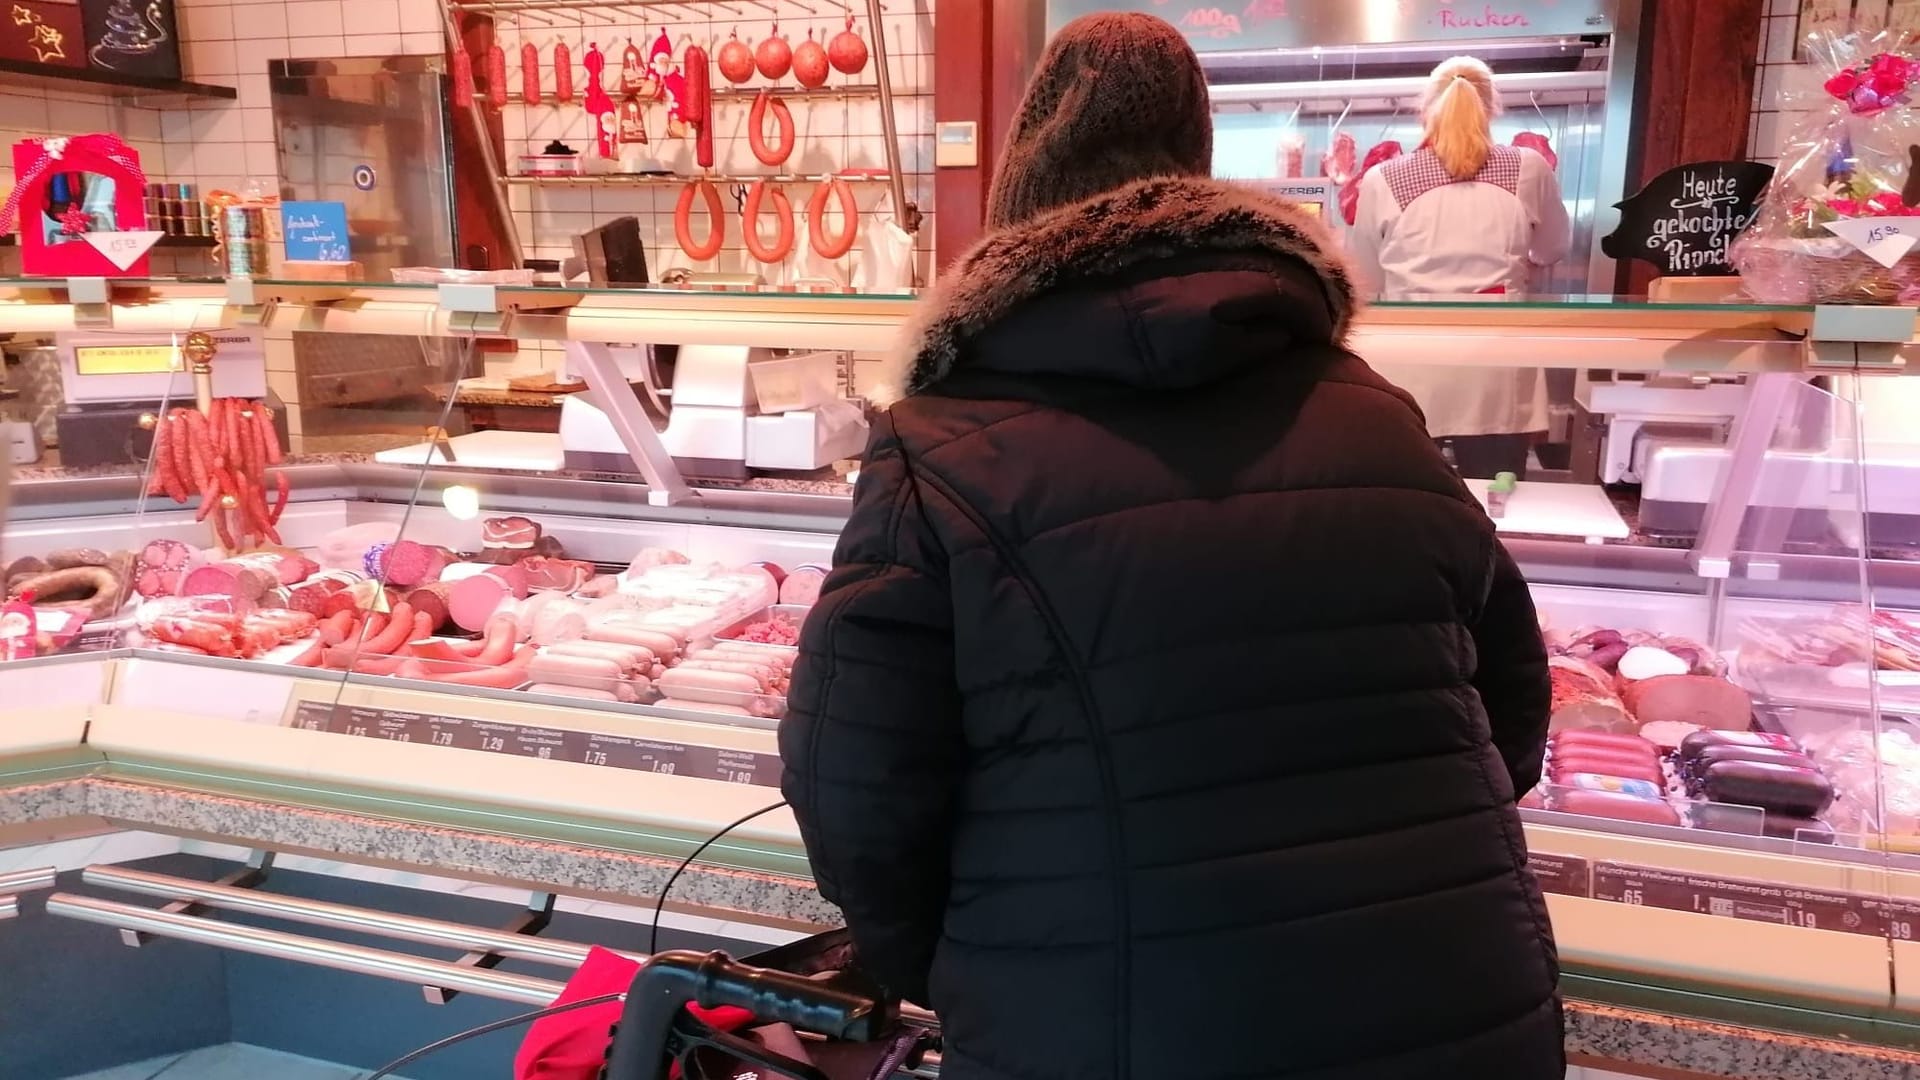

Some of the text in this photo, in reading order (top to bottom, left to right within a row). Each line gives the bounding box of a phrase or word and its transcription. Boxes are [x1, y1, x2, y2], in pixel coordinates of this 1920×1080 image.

[1682, 166, 1737, 199] Heute
[1646, 205, 1746, 249] gekochte
[431, 731, 454, 746] 1.79
[481, 736, 505, 752] 1.29
[584, 750, 608, 766] 1.75
